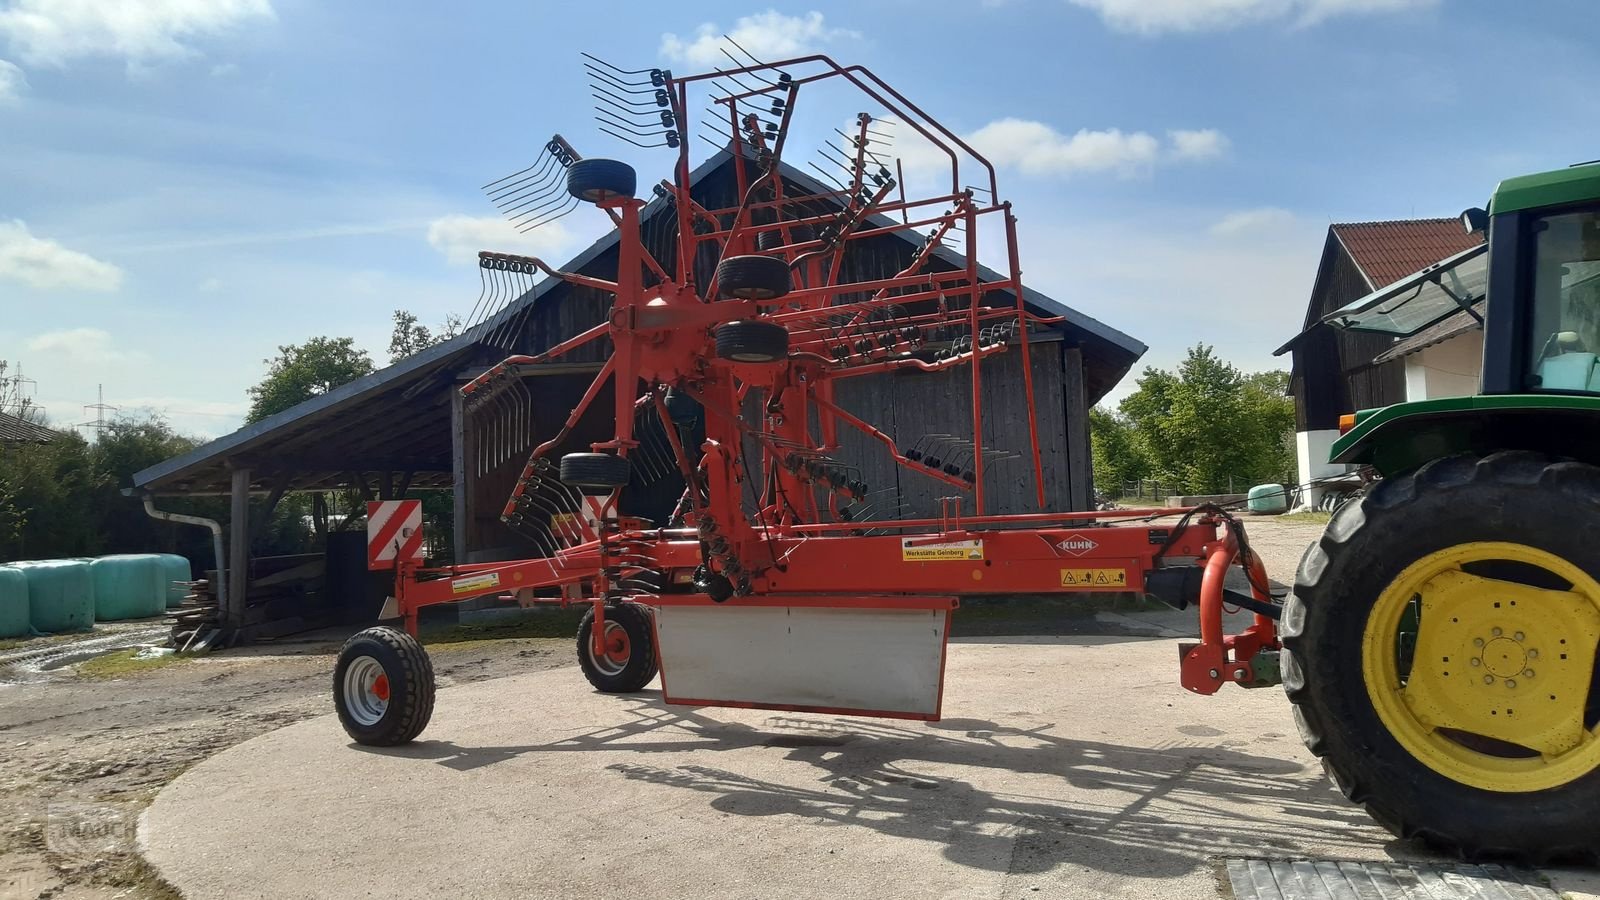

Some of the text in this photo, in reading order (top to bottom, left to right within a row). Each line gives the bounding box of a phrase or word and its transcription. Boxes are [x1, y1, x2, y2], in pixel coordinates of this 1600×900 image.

[1062, 541, 1093, 550] KUHN
[905, 549, 964, 557] Werkstätte Geinberg
